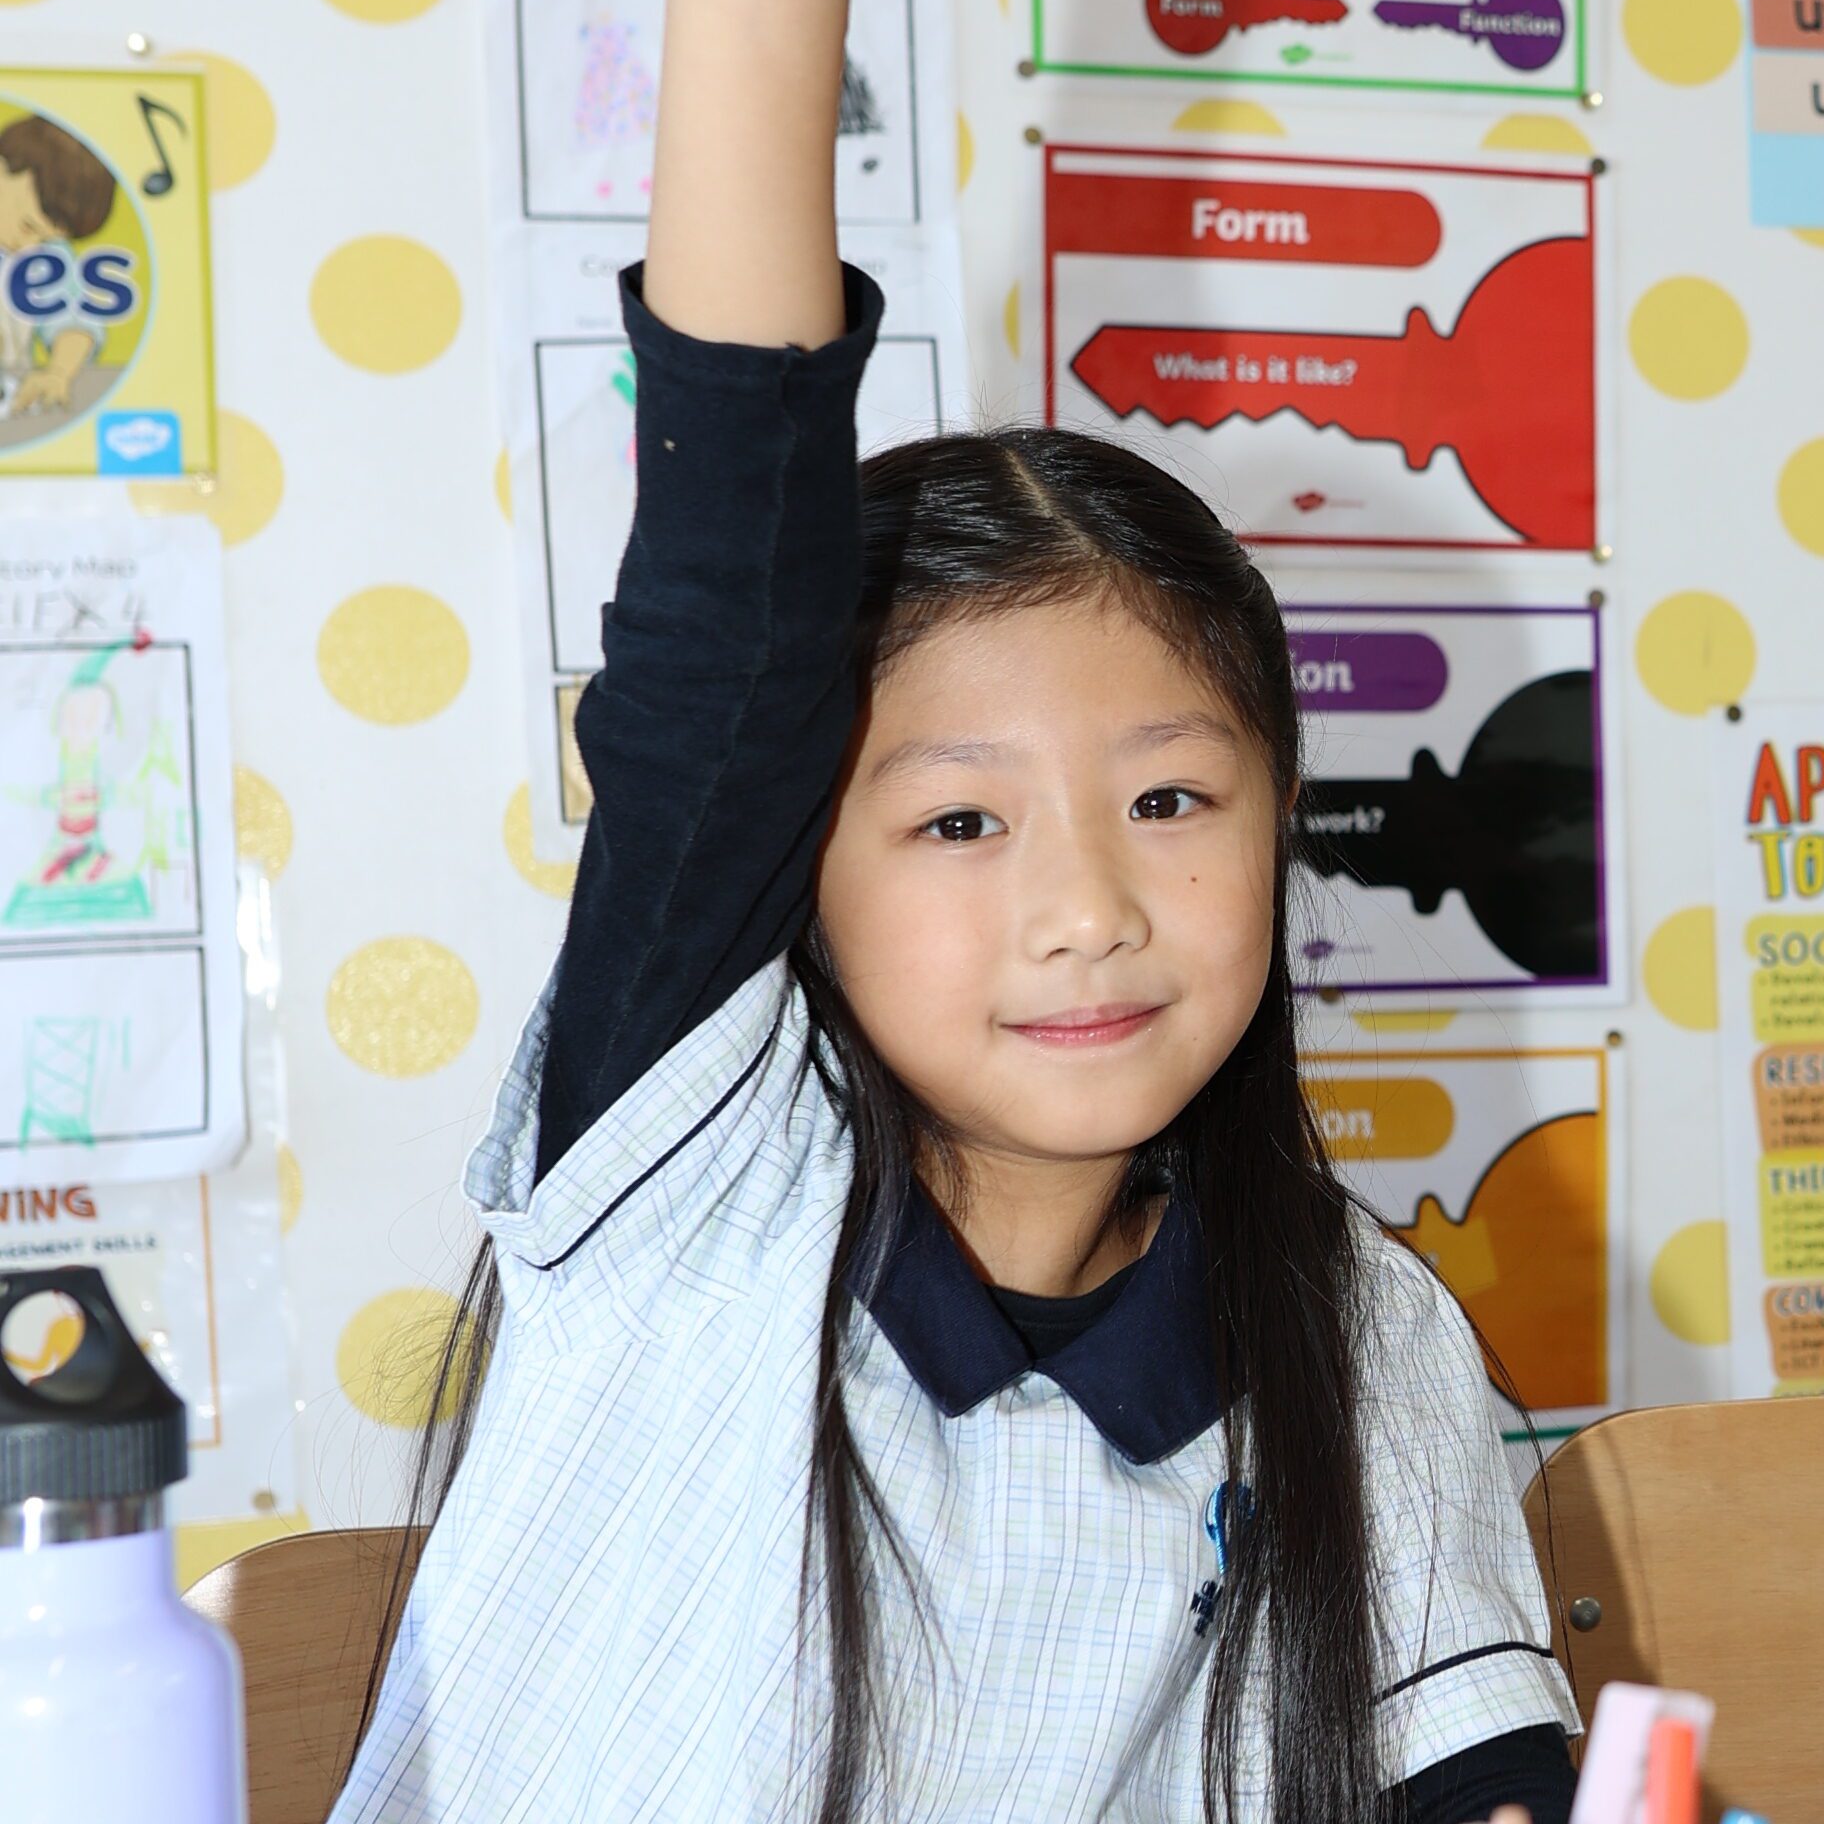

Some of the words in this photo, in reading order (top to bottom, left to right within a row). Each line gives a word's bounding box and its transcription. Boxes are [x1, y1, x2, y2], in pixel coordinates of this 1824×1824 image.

[1459, 11, 1562, 37] Function
[1191, 198, 1310, 245] Form
[0, 251, 136, 318] es
[1154, 352, 1228, 382] What
[1236, 356, 1261, 383] is
[1267, 357, 1288, 384] it
[1295, 357, 1358, 386] like?
[1302, 805, 1385, 833] work?
